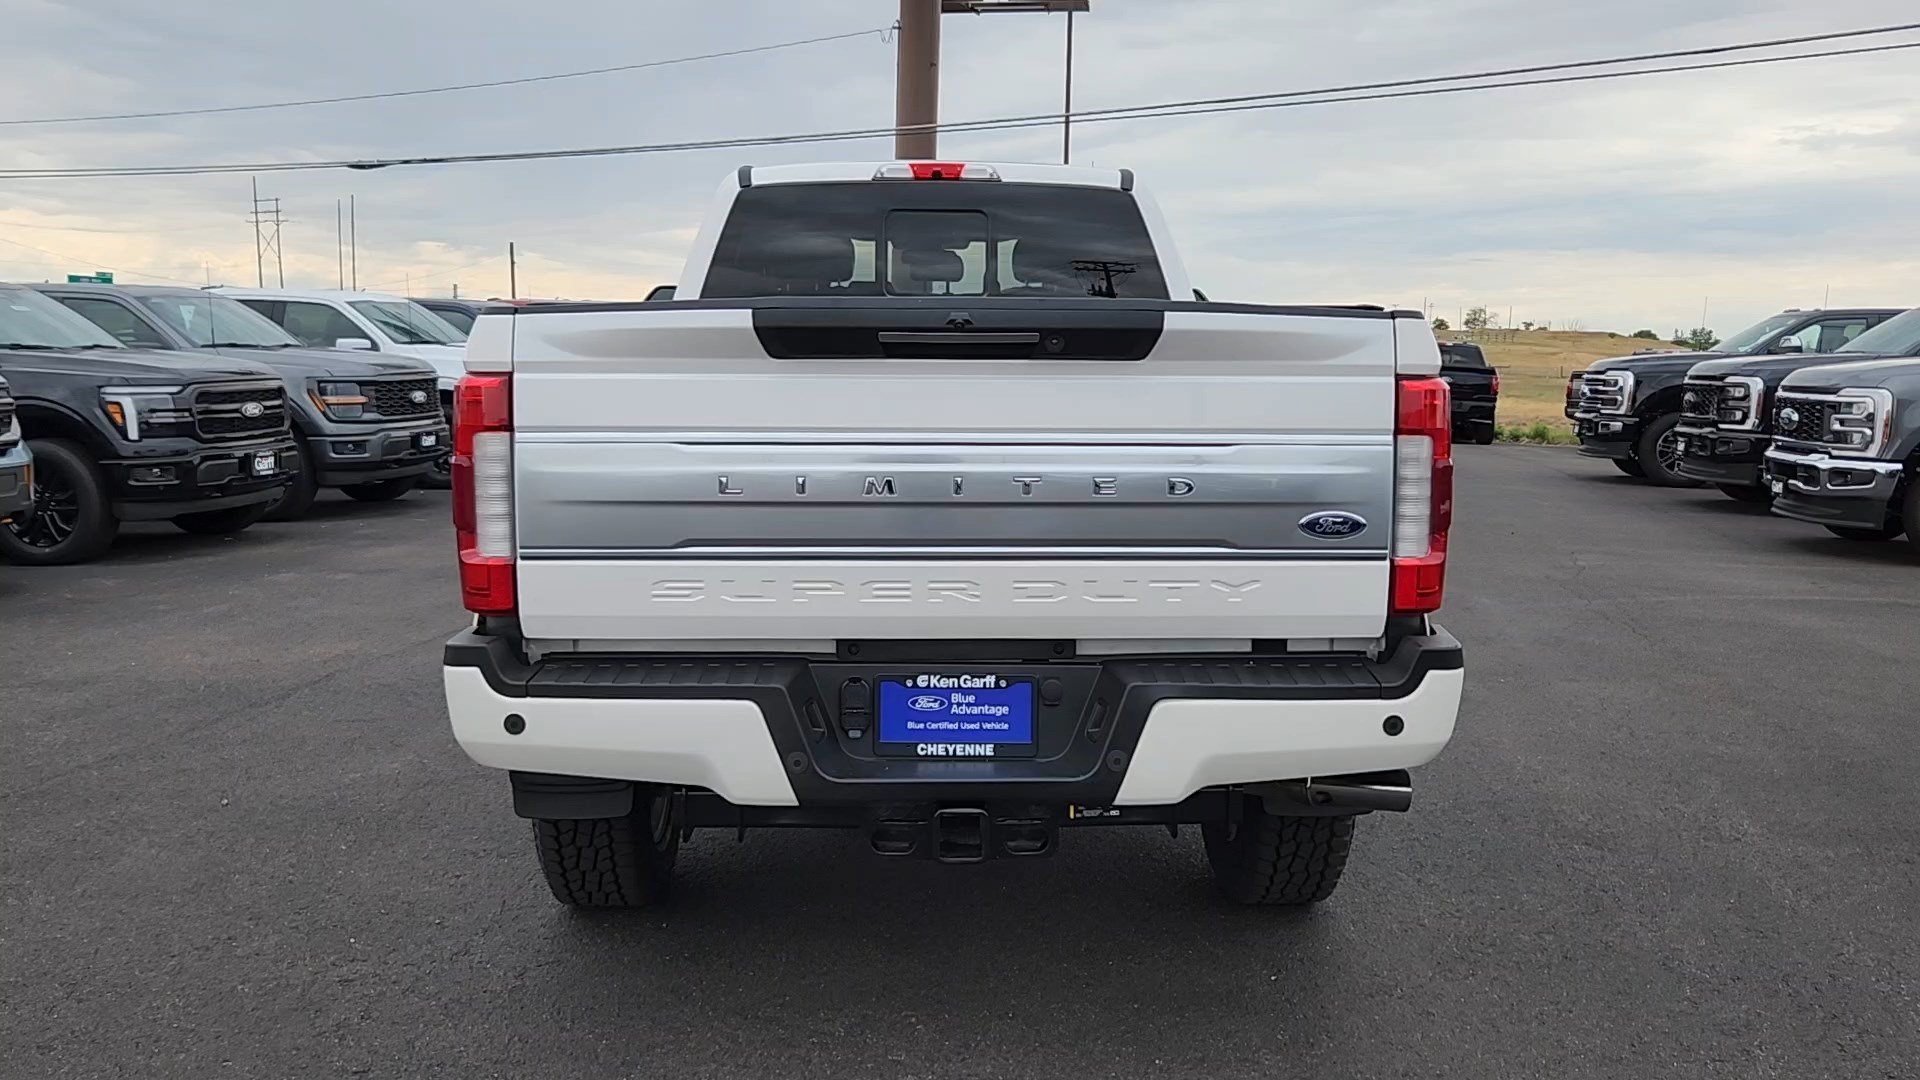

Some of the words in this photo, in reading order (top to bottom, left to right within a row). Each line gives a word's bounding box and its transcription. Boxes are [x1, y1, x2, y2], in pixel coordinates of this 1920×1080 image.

[718, 475, 1197, 498] LIMITED
[1315, 516, 1352, 533] Ford
[651, 578, 983, 604] SUPER
[1011, 578, 1262, 604] DUTY
[930, 675, 959, 688] Ken
[960, 675, 996, 688] Garff
[915, 697, 941, 709] Ford
[951, 693, 976, 703] Blue
[950, 704, 1010, 716] Advantage
[907, 721, 924, 729] Blue
[926, 721, 958, 729] Certified
[960, 721, 980, 729] Used
[982, 721, 1009, 730] Vehicle
[917, 743, 994, 756] CHEYENNE
